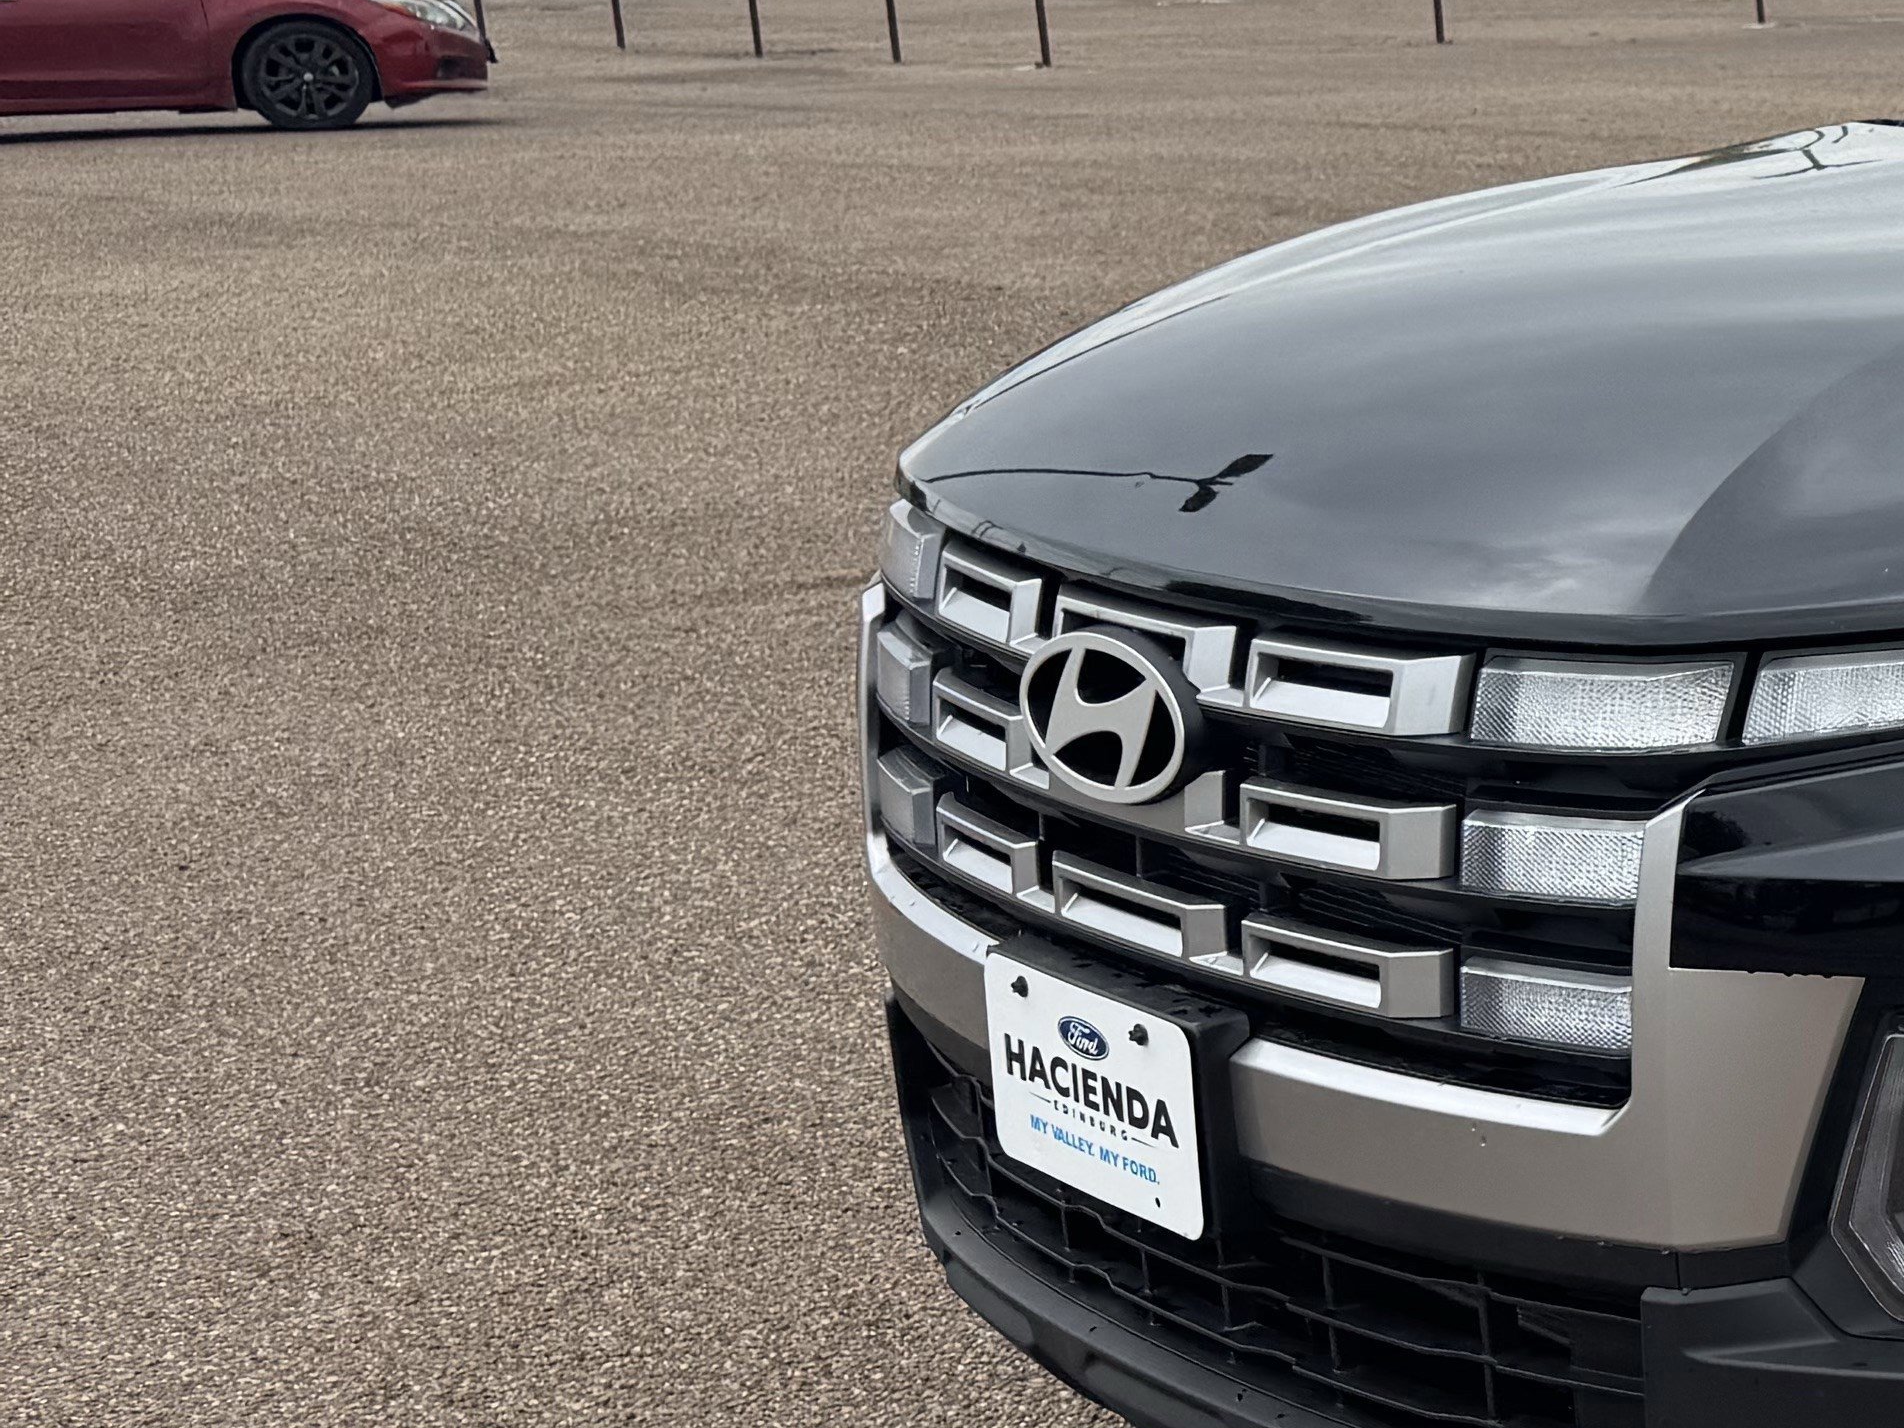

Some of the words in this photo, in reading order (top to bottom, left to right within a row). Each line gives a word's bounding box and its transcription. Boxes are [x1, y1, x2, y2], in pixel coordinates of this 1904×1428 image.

[1004, 1032, 1180, 1149] HACIENDA
[1053, 1099, 1129, 1142] EDINBURG
[1030, 1113, 1049, 1135] MY
[1099, 1145, 1120, 1168] MY
[1122, 1156, 1160, 1185] FORD.
